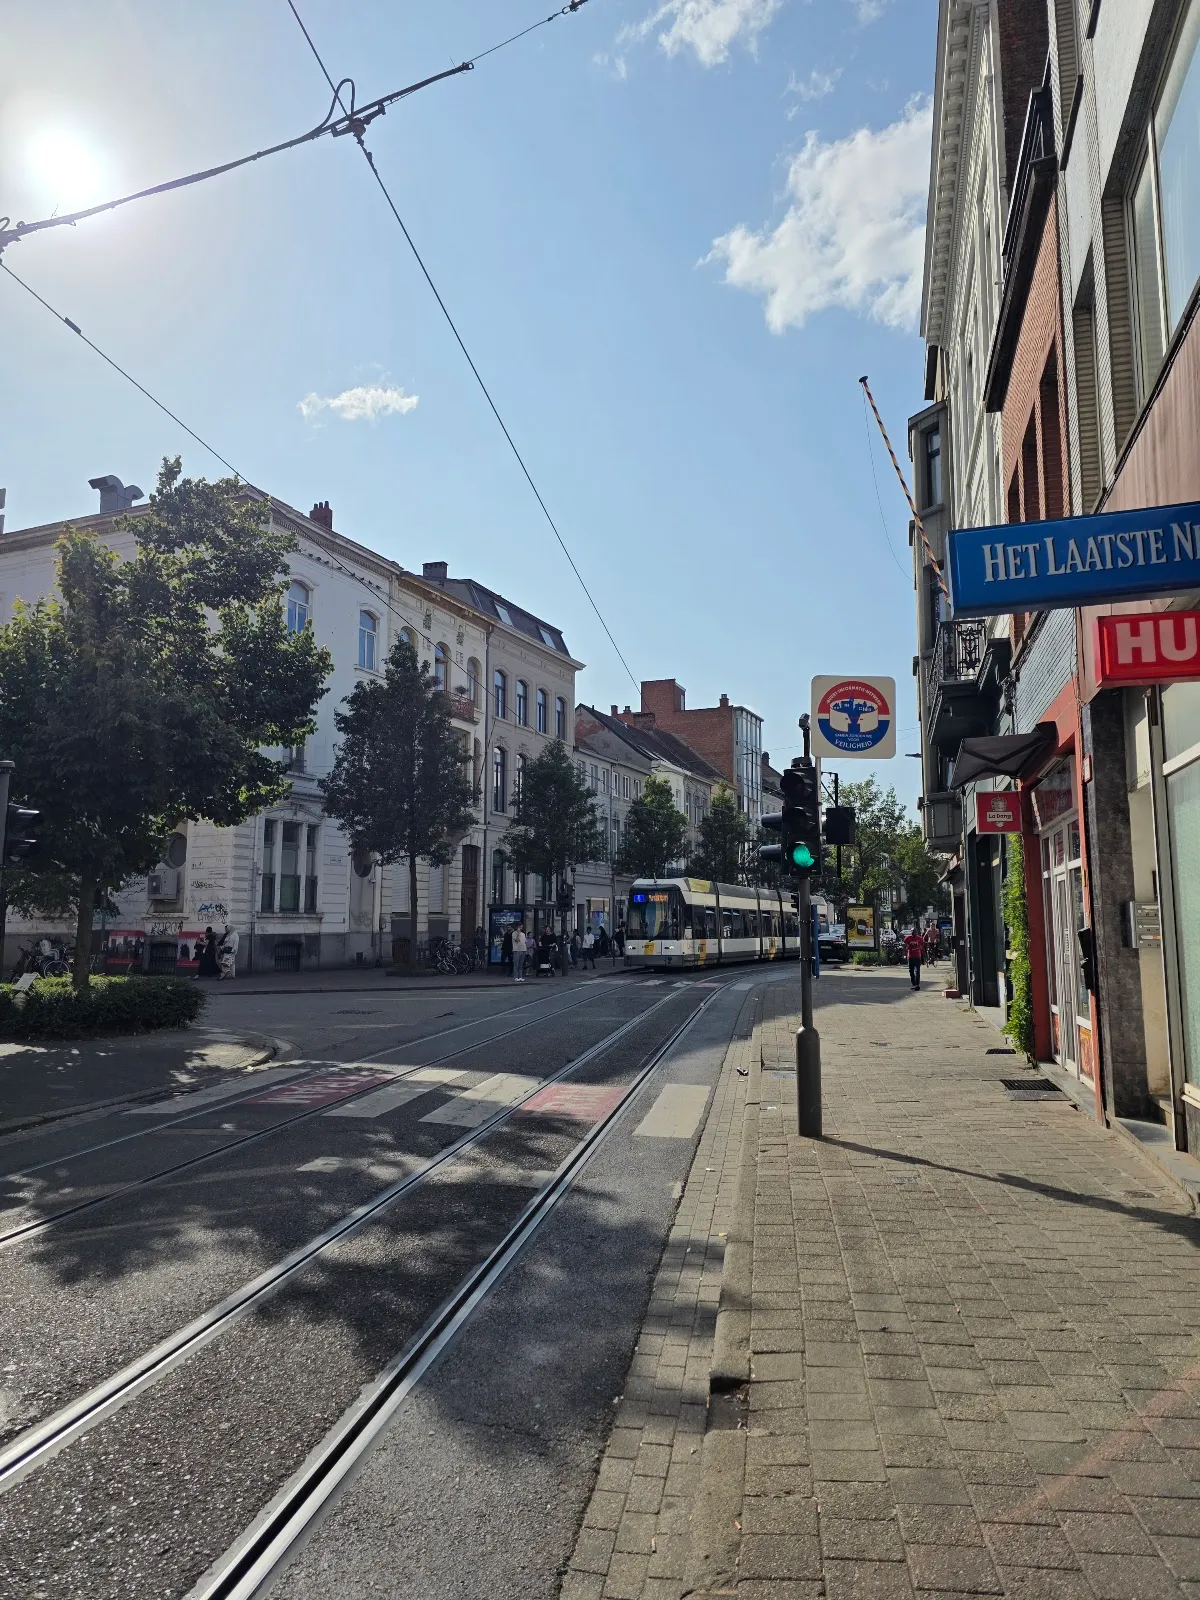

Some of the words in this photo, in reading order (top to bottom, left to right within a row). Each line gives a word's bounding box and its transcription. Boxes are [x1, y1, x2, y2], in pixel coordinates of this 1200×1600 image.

[982, 543, 1041, 583] HET
[1044, 528, 1167, 576] LAATSTE
[834, 739, 873, 749] VEILIGHEID
